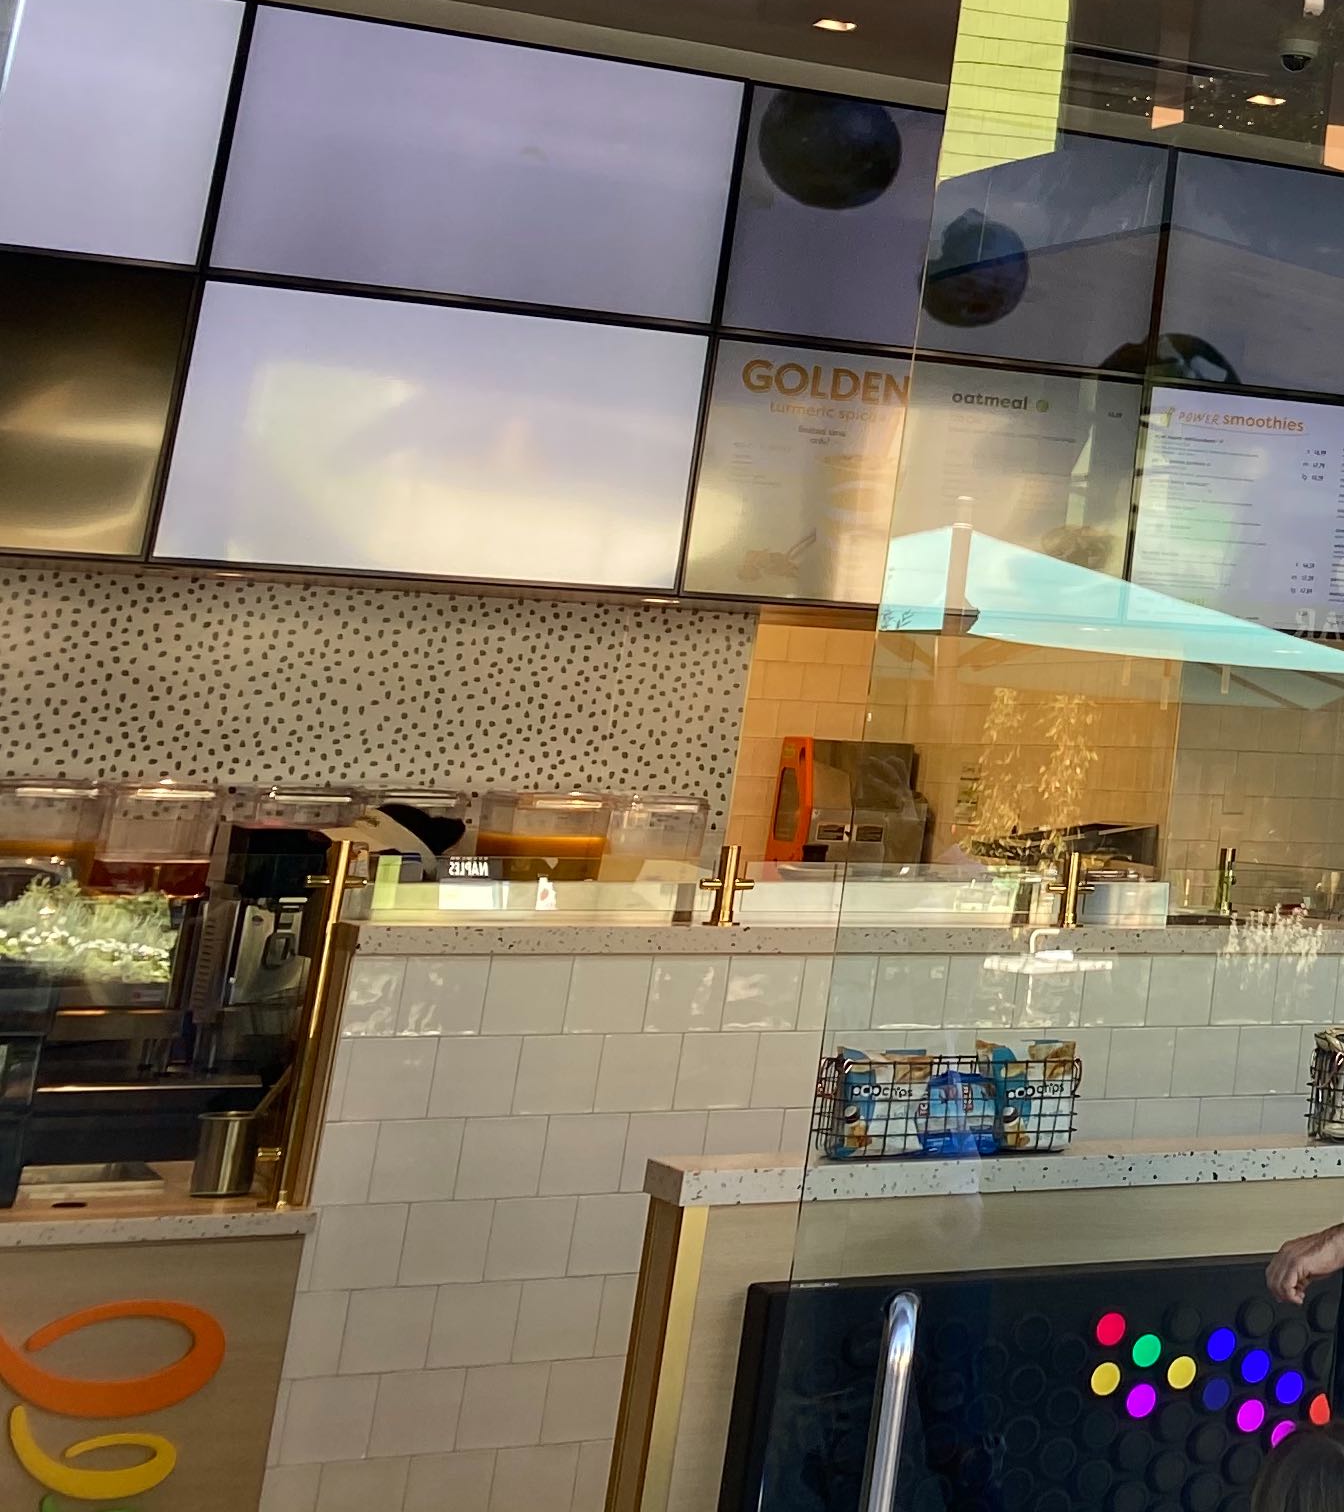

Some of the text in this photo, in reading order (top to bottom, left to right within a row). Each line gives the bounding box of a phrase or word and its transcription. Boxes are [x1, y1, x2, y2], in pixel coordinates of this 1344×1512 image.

[741, 358, 910, 406] GOLDEN
[769, 400, 835, 419] turmeric
[951, 391, 1029, 410] oatmeal
[1177, 411, 1305, 432] POWER smoothies
